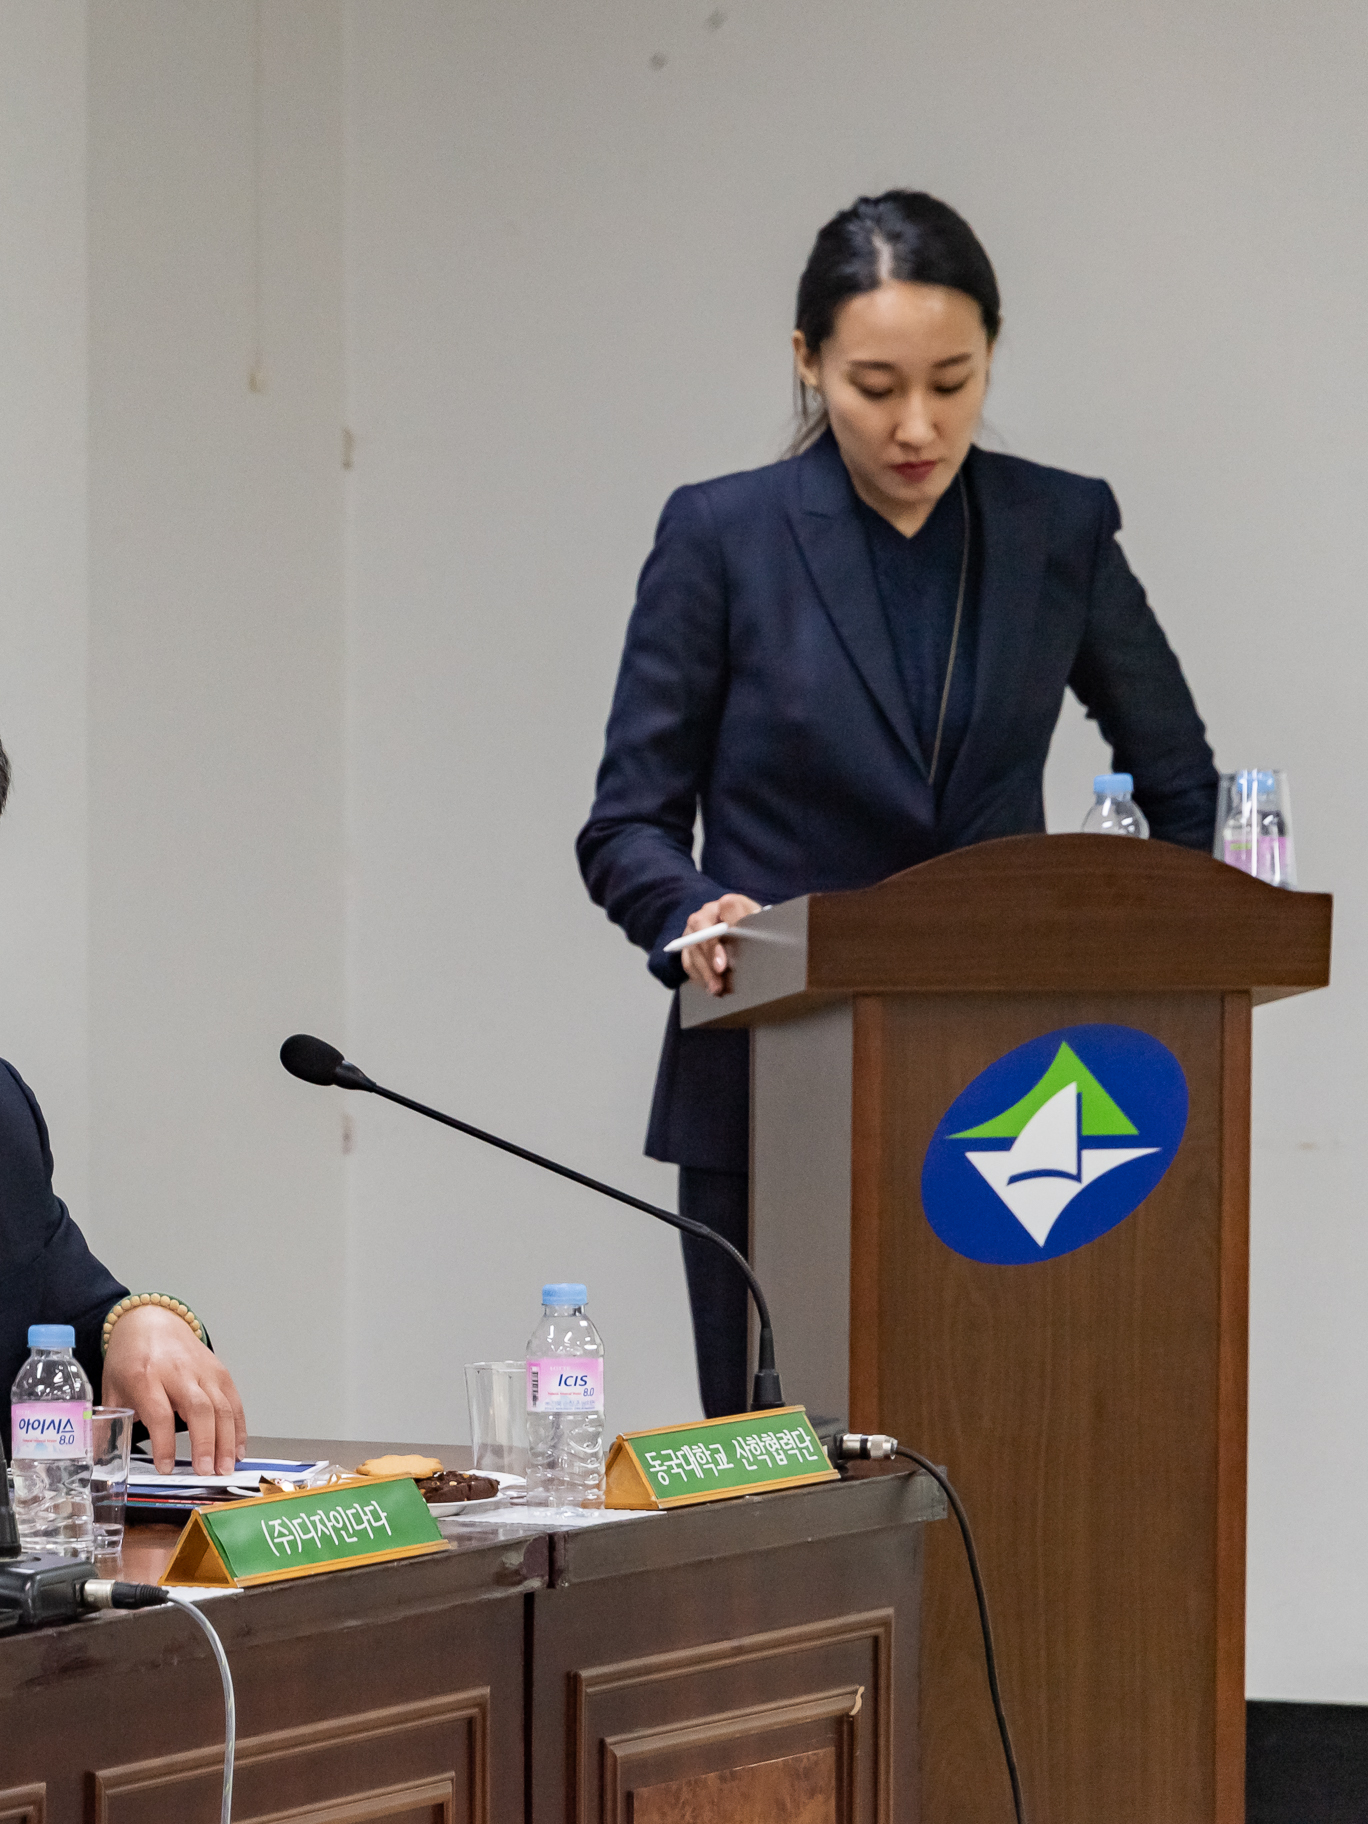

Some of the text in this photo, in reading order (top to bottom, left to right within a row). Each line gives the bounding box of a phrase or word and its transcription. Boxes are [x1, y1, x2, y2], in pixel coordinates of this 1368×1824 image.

[583, 1387, 595, 1397] 8.0
[18, 1418, 75, 1435] 아이시스
[58, 1434, 75, 1445] 8.0
[644, 1426, 819, 1486] 동국대학교 산학협력단
[260, 1500, 392, 1557] (주)디자인다다
